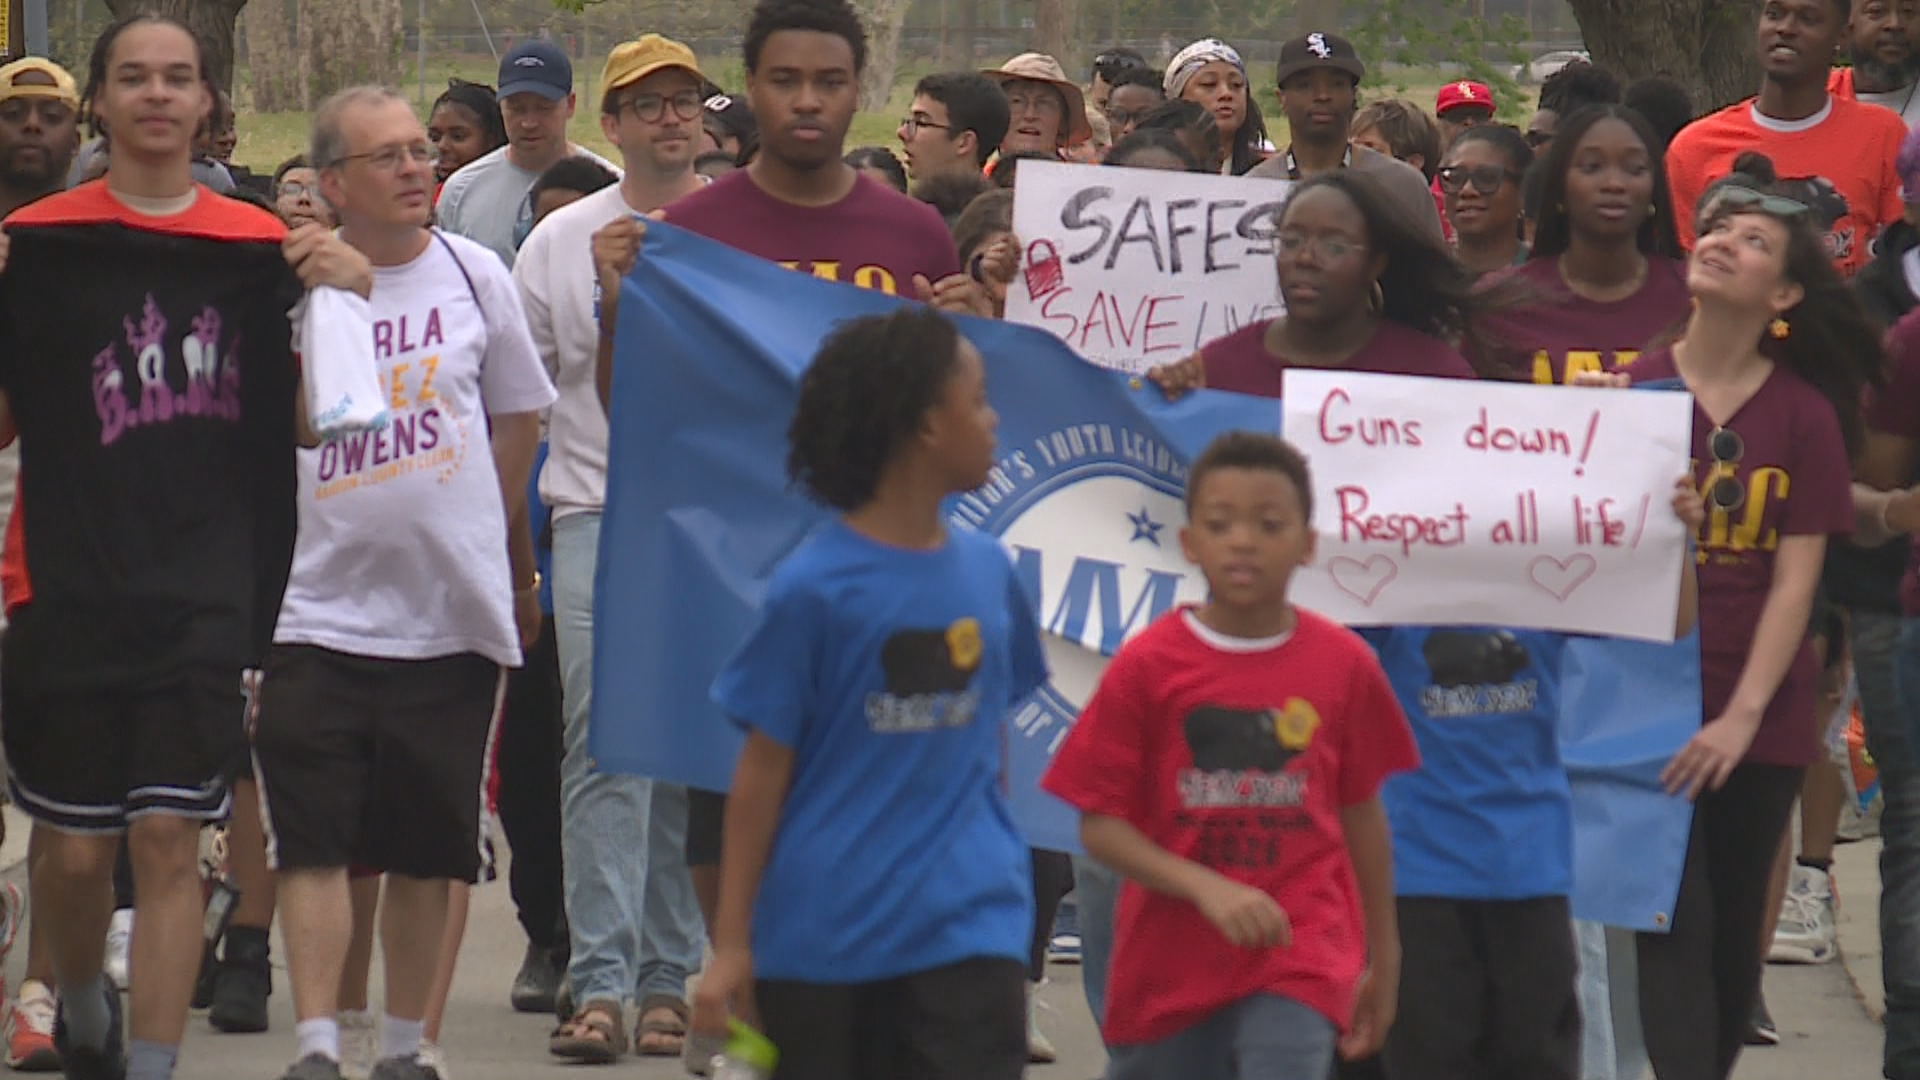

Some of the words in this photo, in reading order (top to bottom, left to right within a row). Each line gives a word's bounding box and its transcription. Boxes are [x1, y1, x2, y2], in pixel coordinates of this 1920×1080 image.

[373, 306, 443, 360] RLA
[1041, 287, 1184, 354] SAVE
[378, 354, 440, 409] EZ
[317, 408, 440, 482] OWENS
[1034, 423, 1116, 467] YOUTH
[1319, 388, 1423, 446] Guns
[1465, 405, 1601, 477] down!
[1336, 486, 1470, 560] Respect
[1490, 489, 1540, 545] all
